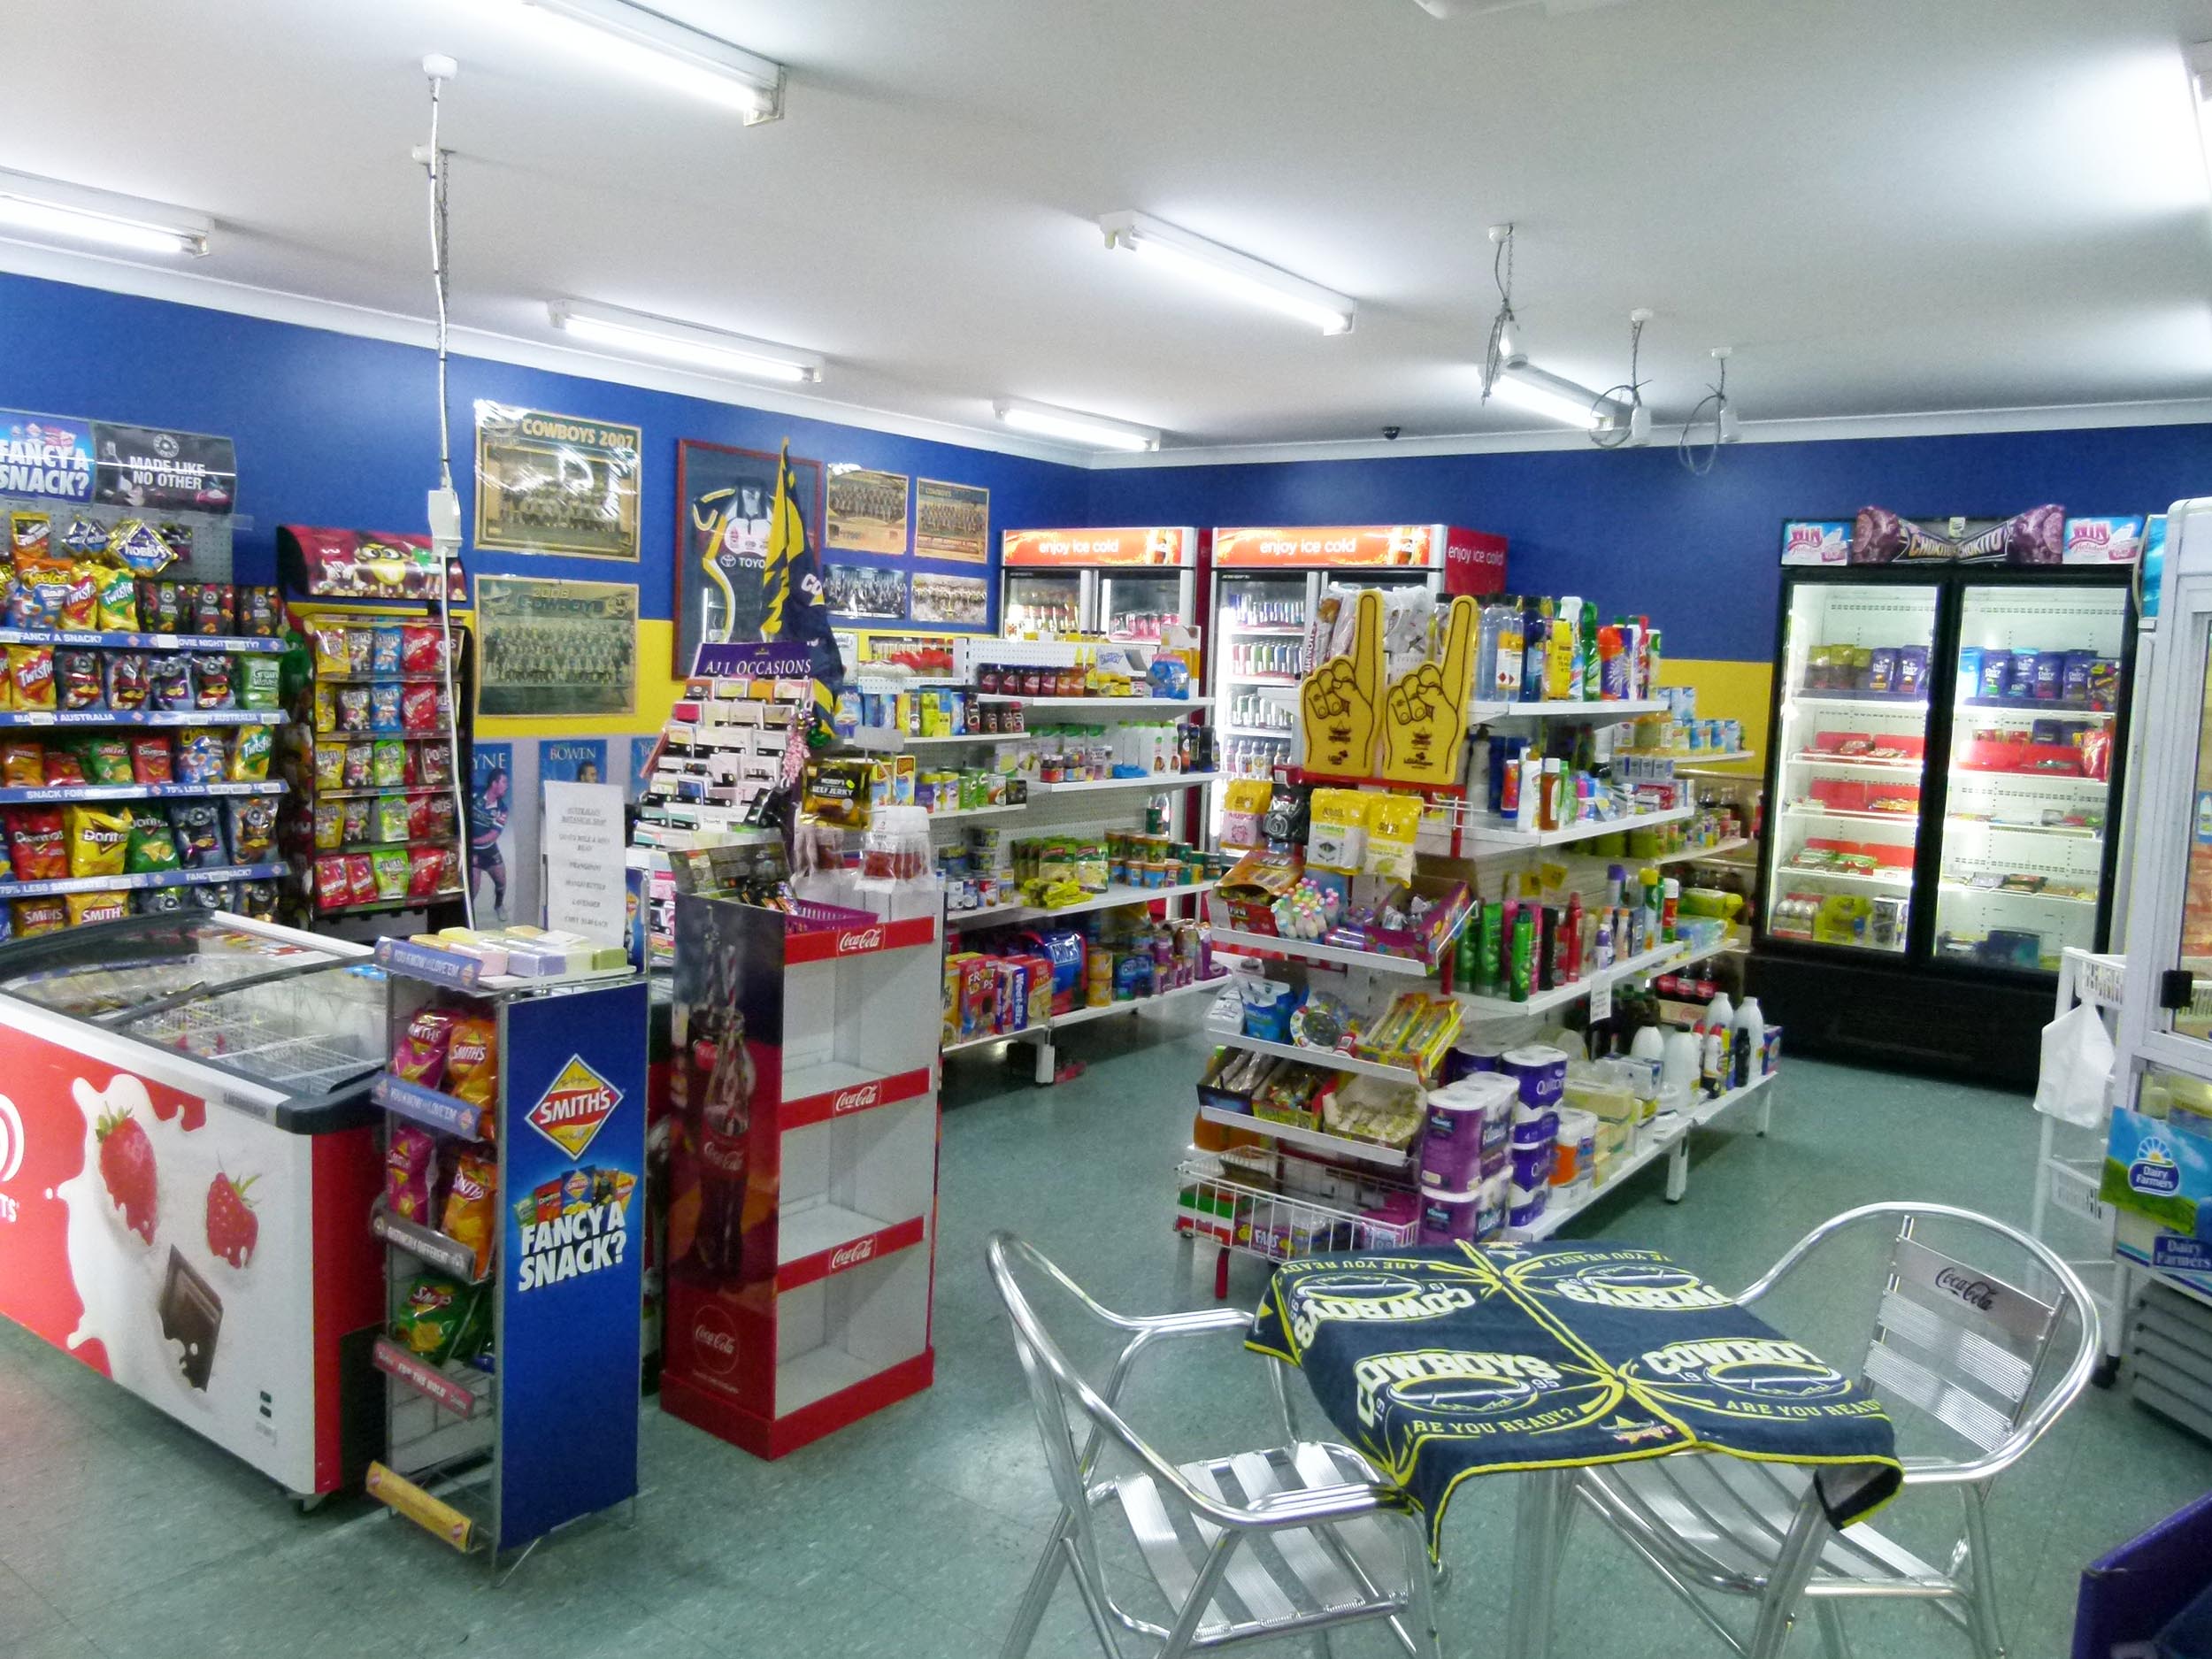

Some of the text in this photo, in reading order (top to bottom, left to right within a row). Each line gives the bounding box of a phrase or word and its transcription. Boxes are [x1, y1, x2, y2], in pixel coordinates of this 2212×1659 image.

[522, 419, 634, 449] COWBOYS 2007
[130, 456, 206, 477] MADE LIKE
[133, 470, 202, 490] NO OTHER
[1039, 539, 1118, 556] enjoy ice cold
[1259, 538, 1356, 557] enjoy ice cold
[1448, 543, 1504, 567] enjoy ice cold
[740, 557, 765, 569] TOYO
[179, 638, 198, 647] OVIE
[737, 659, 811, 675] OCCASIONS
[60, 712, 115, 723] AUSTRALIA
[472, 752, 507, 771] YNE
[549, 746, 597, 762] BOWEN
[27, 788, 61, 800] SNACK
[828, 787, 853, 796] JERKY
[186, 871, 212, 882] FANC
[24, 883, 49, 894] LESS
[840, 929, 882, 952] Coca-Cola
[540, 1086, 611, 1125] SMITH'S
[835, 1084, 876, 1112] Coca-Cola
[2143, 1165, 2169, 1181] Dairy
[2136, 1175, 2173, 1189] Farmers
[519, 1201, 626, 1257] FANCY A
[831, 1239, 872, 1269] Coca-Cola
[2168, 1239, 2202, 1256] Dairy
[518, 1231, 626, 1292] SNACK?
[1343, 1260, 1378, 1271] YOU
[1383, 1260, 1419, 1271] ARE
[2156, 1253, 2211, 1270] Farmers
[1935, 1267, 1998, 1311] Coca-Cola
[1294, 1287, 1476, 1347] COWBOYS
[695, 1325, 735, 1355] Coca-Cola
[1641, 1340, 1827, 1375] COWBOY
[1532, 1376, 1561, 1390] 95
[1676, 1372, 1702, 1383] 19
[1356, 1352, 1563, 1428] COWBOYS
[1726, 1401, 1774, 1415] ARE
[1776, 1405, 1822, 1417] YOU
[1448, 1422, 1496, 1435] YOU
[1497, 1408, 1578, 1433] READY?
